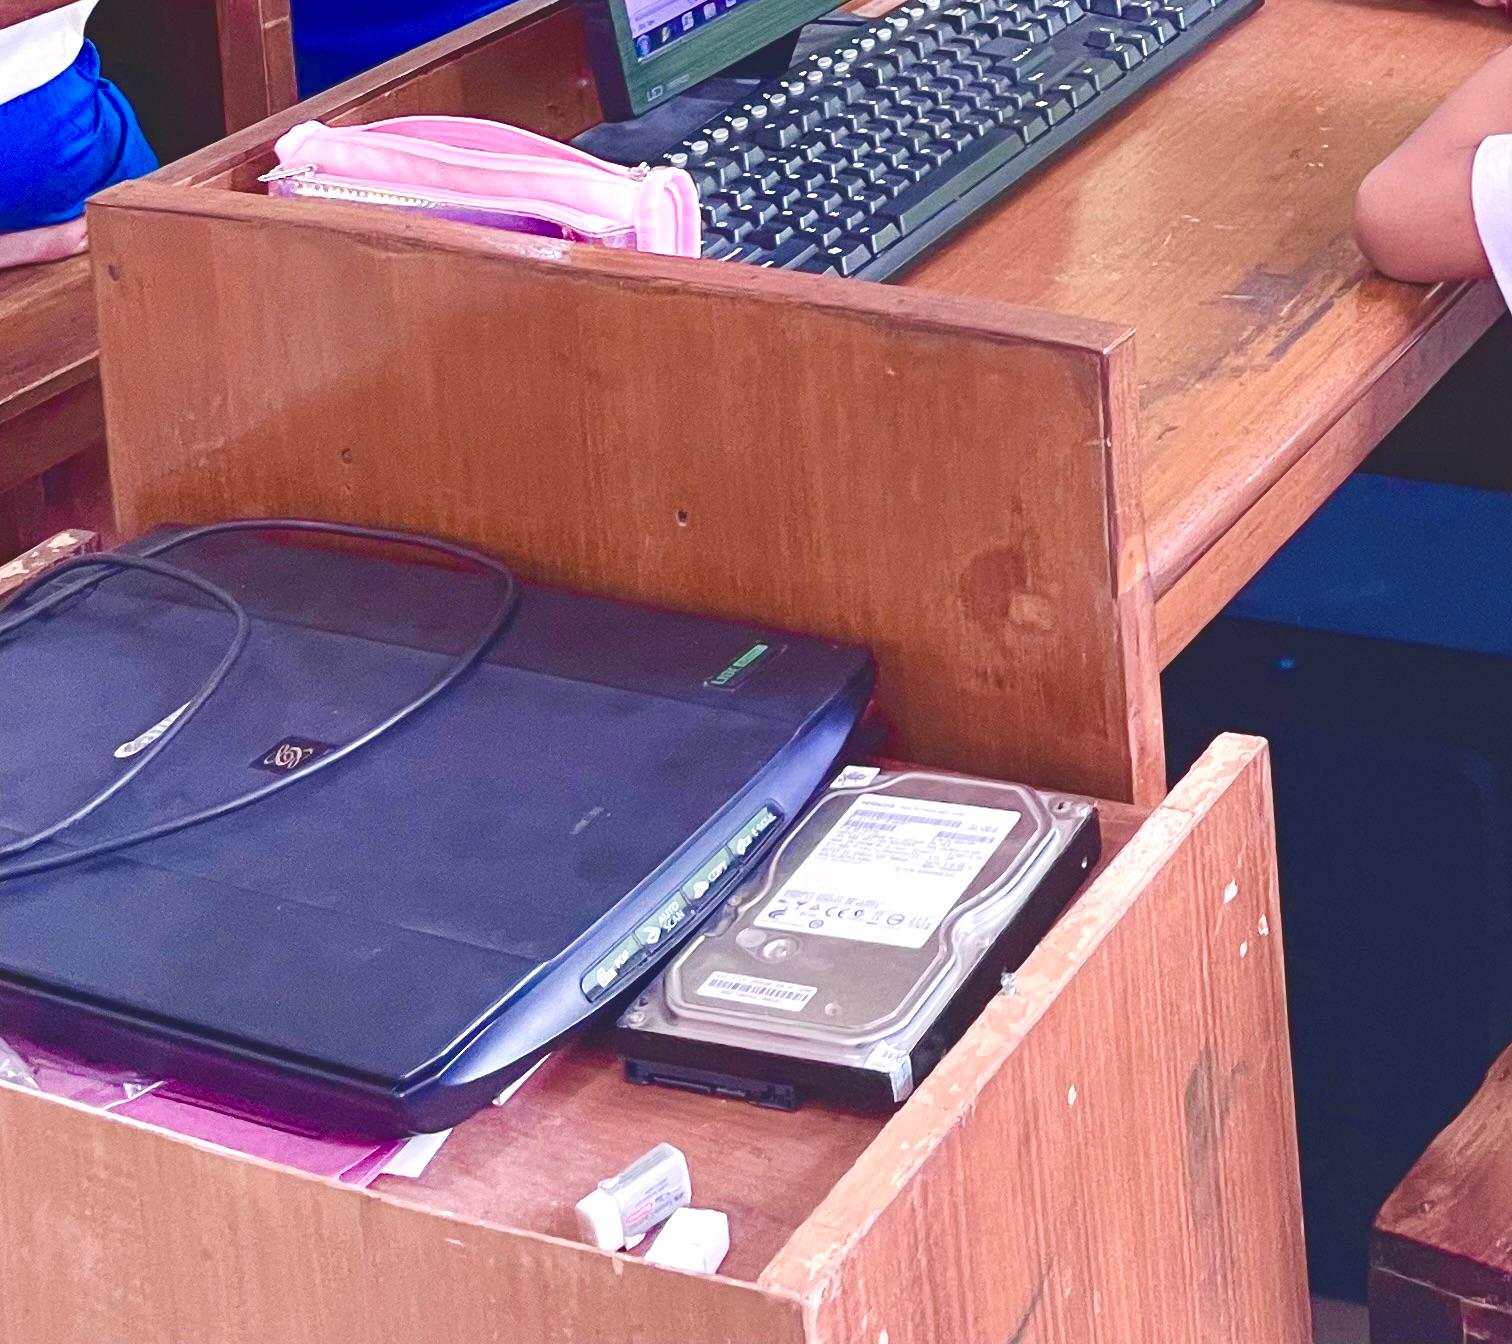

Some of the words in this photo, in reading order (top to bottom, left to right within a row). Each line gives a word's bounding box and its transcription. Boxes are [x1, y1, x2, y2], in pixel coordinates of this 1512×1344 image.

[708, 861, 728, 882] COPY
[658, 901, 680, 927] AUTO
[663, 910, 686, 933] SCAN
